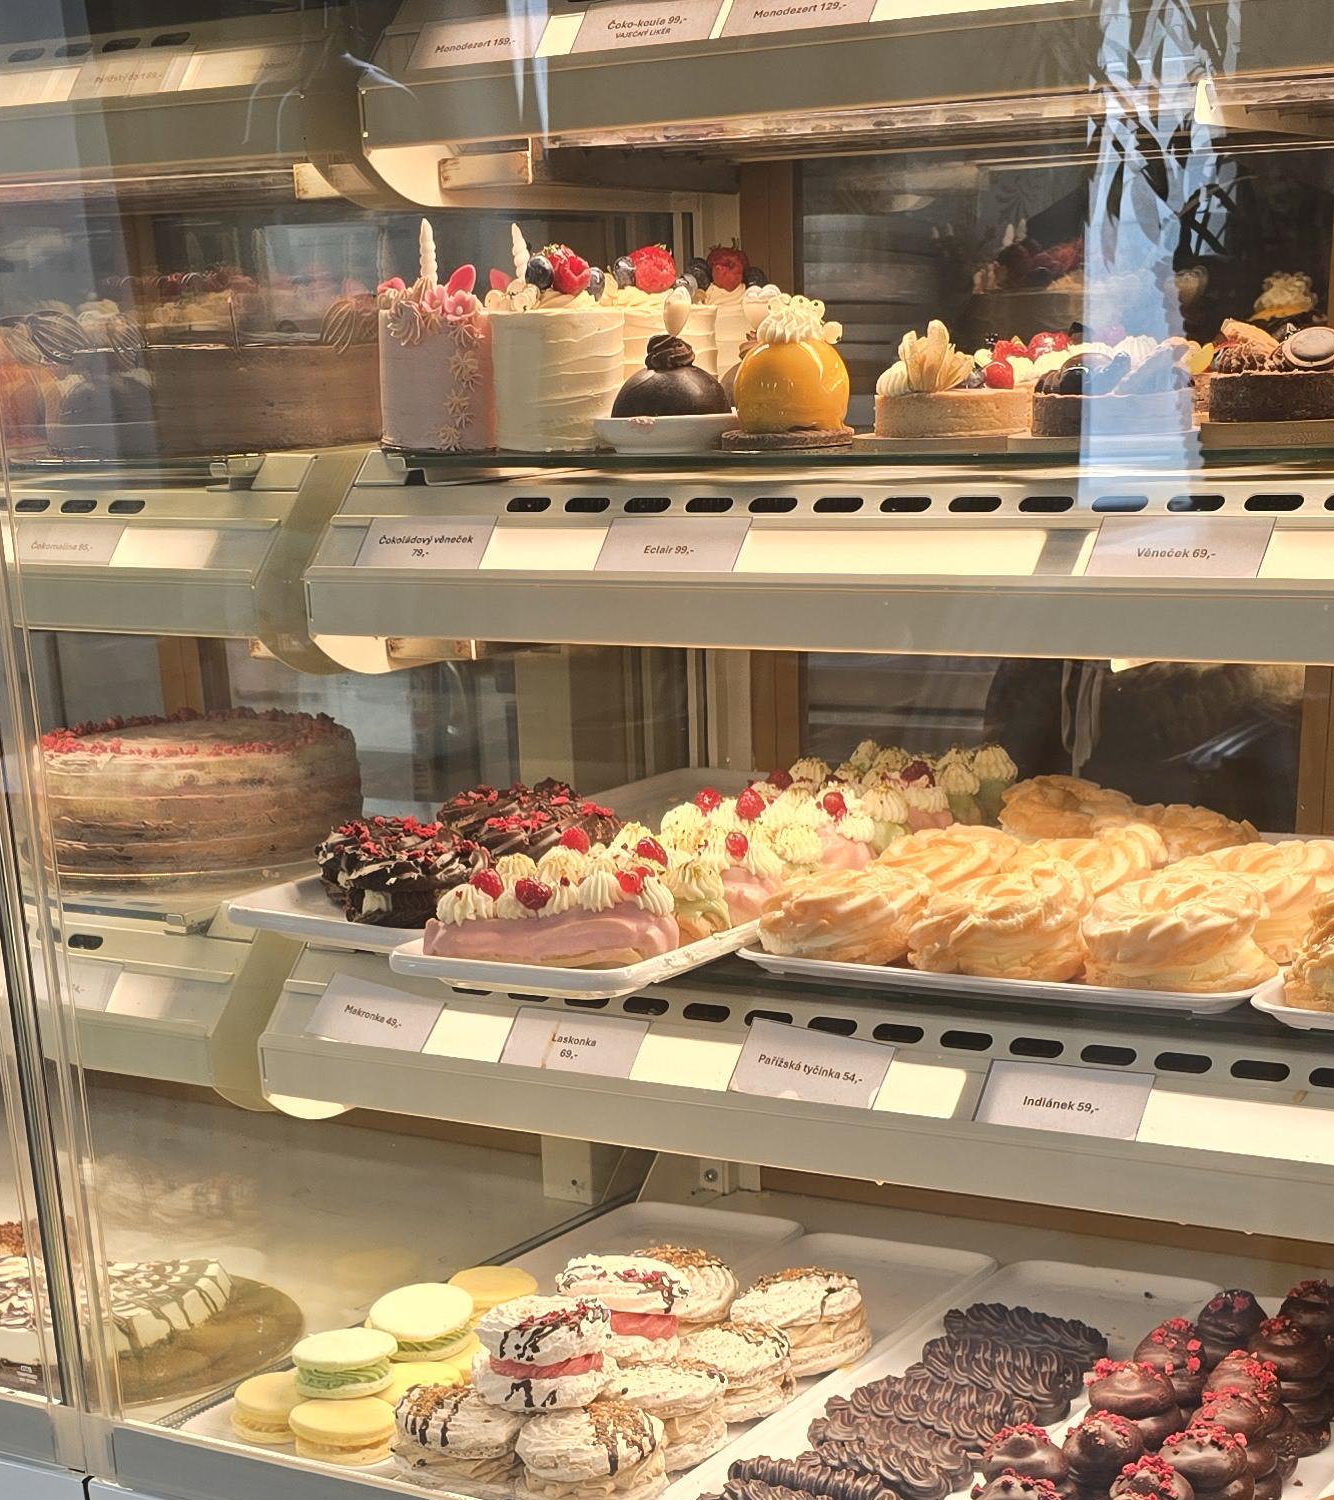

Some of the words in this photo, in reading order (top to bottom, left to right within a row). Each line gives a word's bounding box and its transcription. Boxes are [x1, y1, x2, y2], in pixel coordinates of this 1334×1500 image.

[753, 4, 818, 19] Monodezert
[821, 1, 847, 11] 129,-
[607, 17, 666, 30] Čoko-koule
[668, 15, 688, 26] 99,-
[434, 38, 492, 55] Monodezert
[494, 36, 516, 48] 159,-
[378, 534, 433, 545] Čokoládový
[434, 534, 473, 544] věneček
[411, 548, 429, 558] 79,-
[643, 544, 673, 555] Eclair
[674, 545, 695, 556] 99,-
[1137, 547, 1190, 558] Věneček
[1192, 548, 1216, 560] 69,-
[344, 1004, 385, 1023] Makronka
[386, 1017, 402, 1029] 49,-
[551, 1032, 597, 1047] Laskonka
[559, 1048, 578, 1060] 69,-
[757, 1053, 802, 1071] Pařížská
[803, 1063, 841, 1079] tyčinka
[841, 1072, 863, 1085] 54,-
[1023, 1095, 1075, 1111] Indiánek
[1076, 1101, 1100, 1114] 59,-
